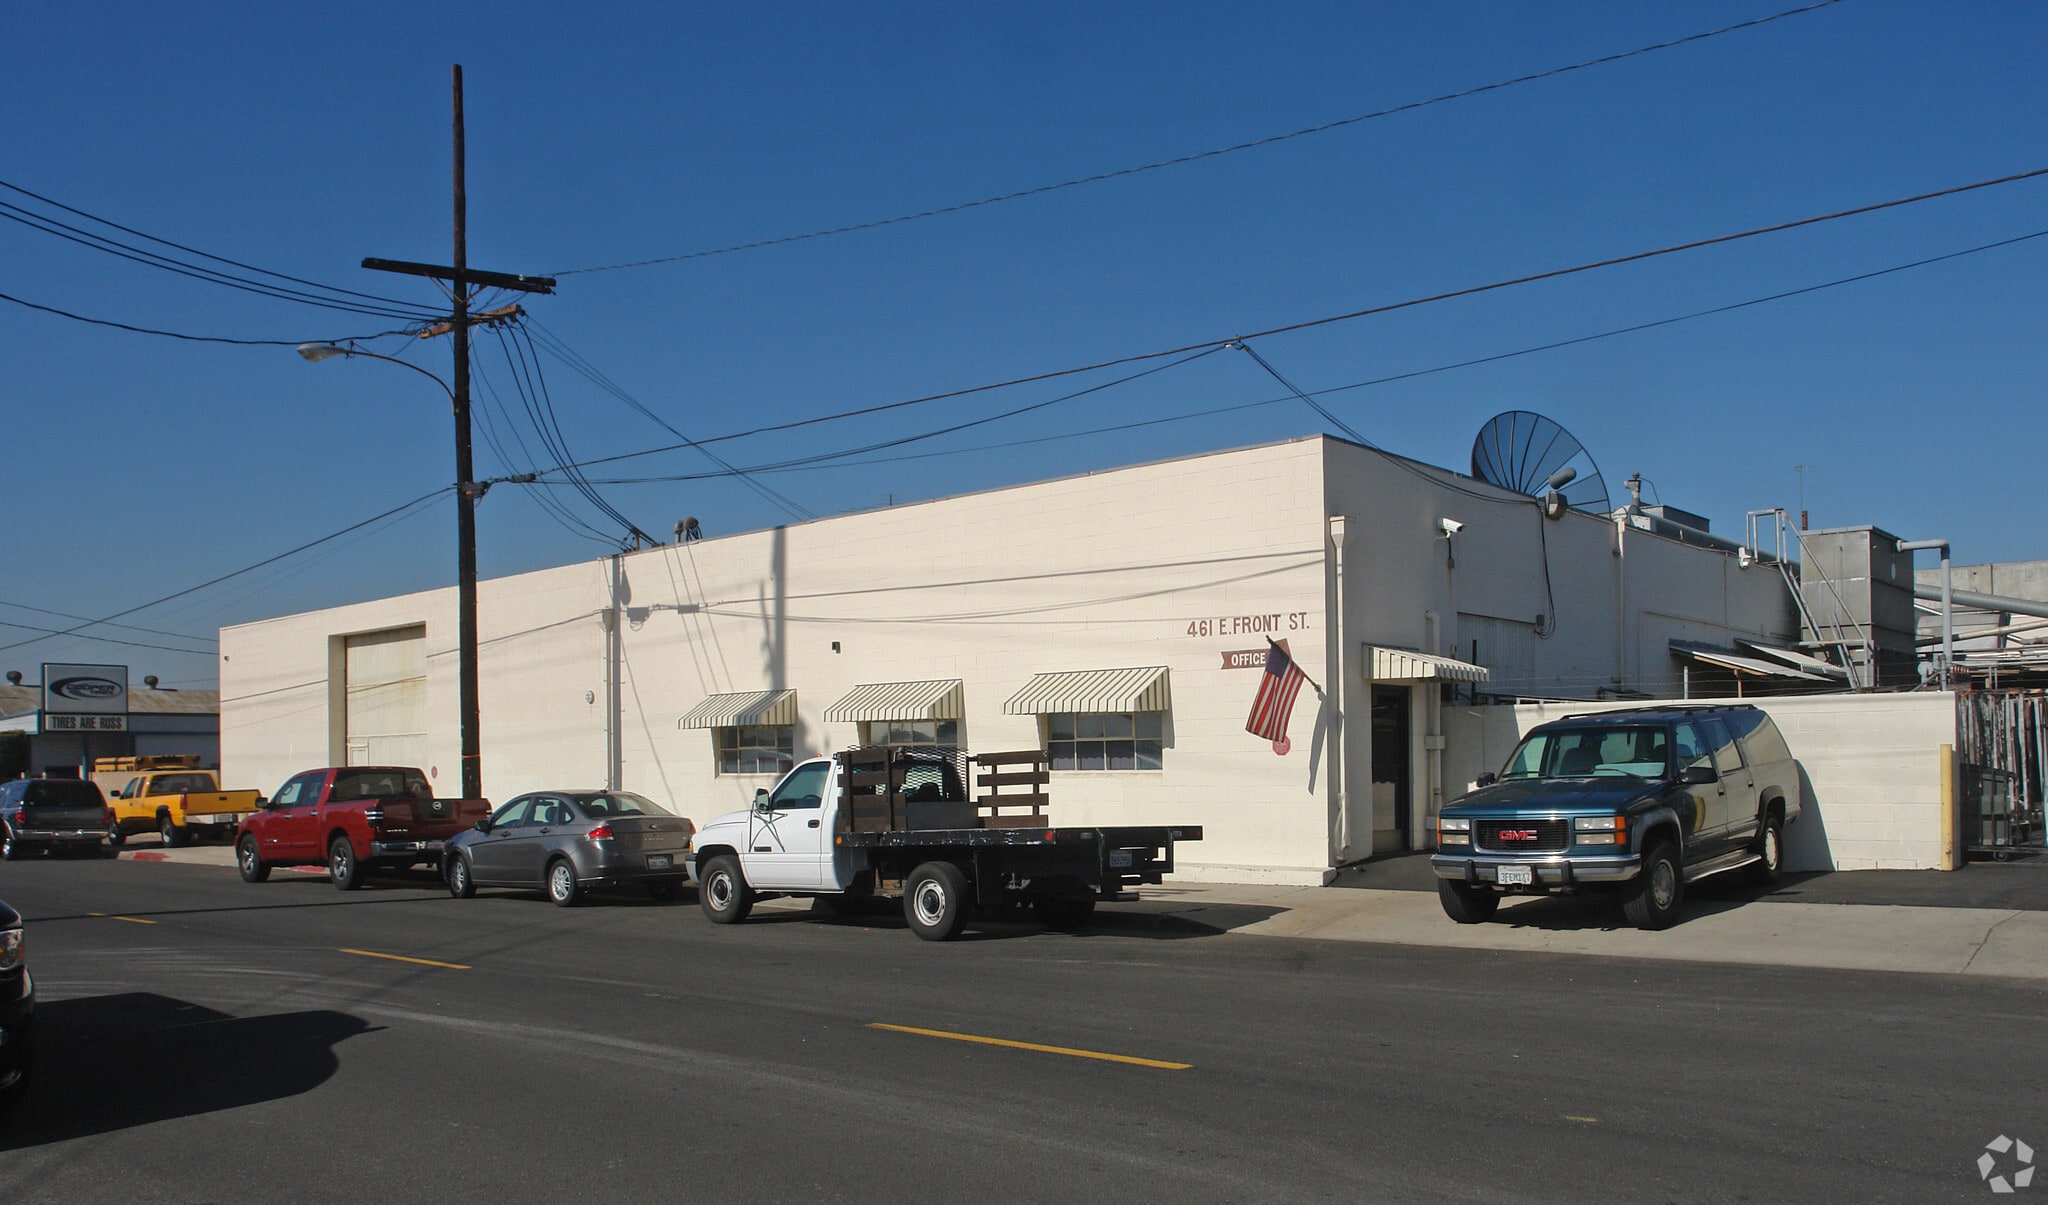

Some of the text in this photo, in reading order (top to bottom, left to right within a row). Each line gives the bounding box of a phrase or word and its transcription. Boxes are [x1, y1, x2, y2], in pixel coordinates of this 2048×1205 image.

[1187, 619, 1213, 637] 461
[1289, 612, 1310, 631] ST.
[1231, 652, 1266, 666] OFFICE
[51, 716, 76, 729] TIRES
[80, 717, 96, 729] ARE
[1500, 830, 1538, 841] GMC
